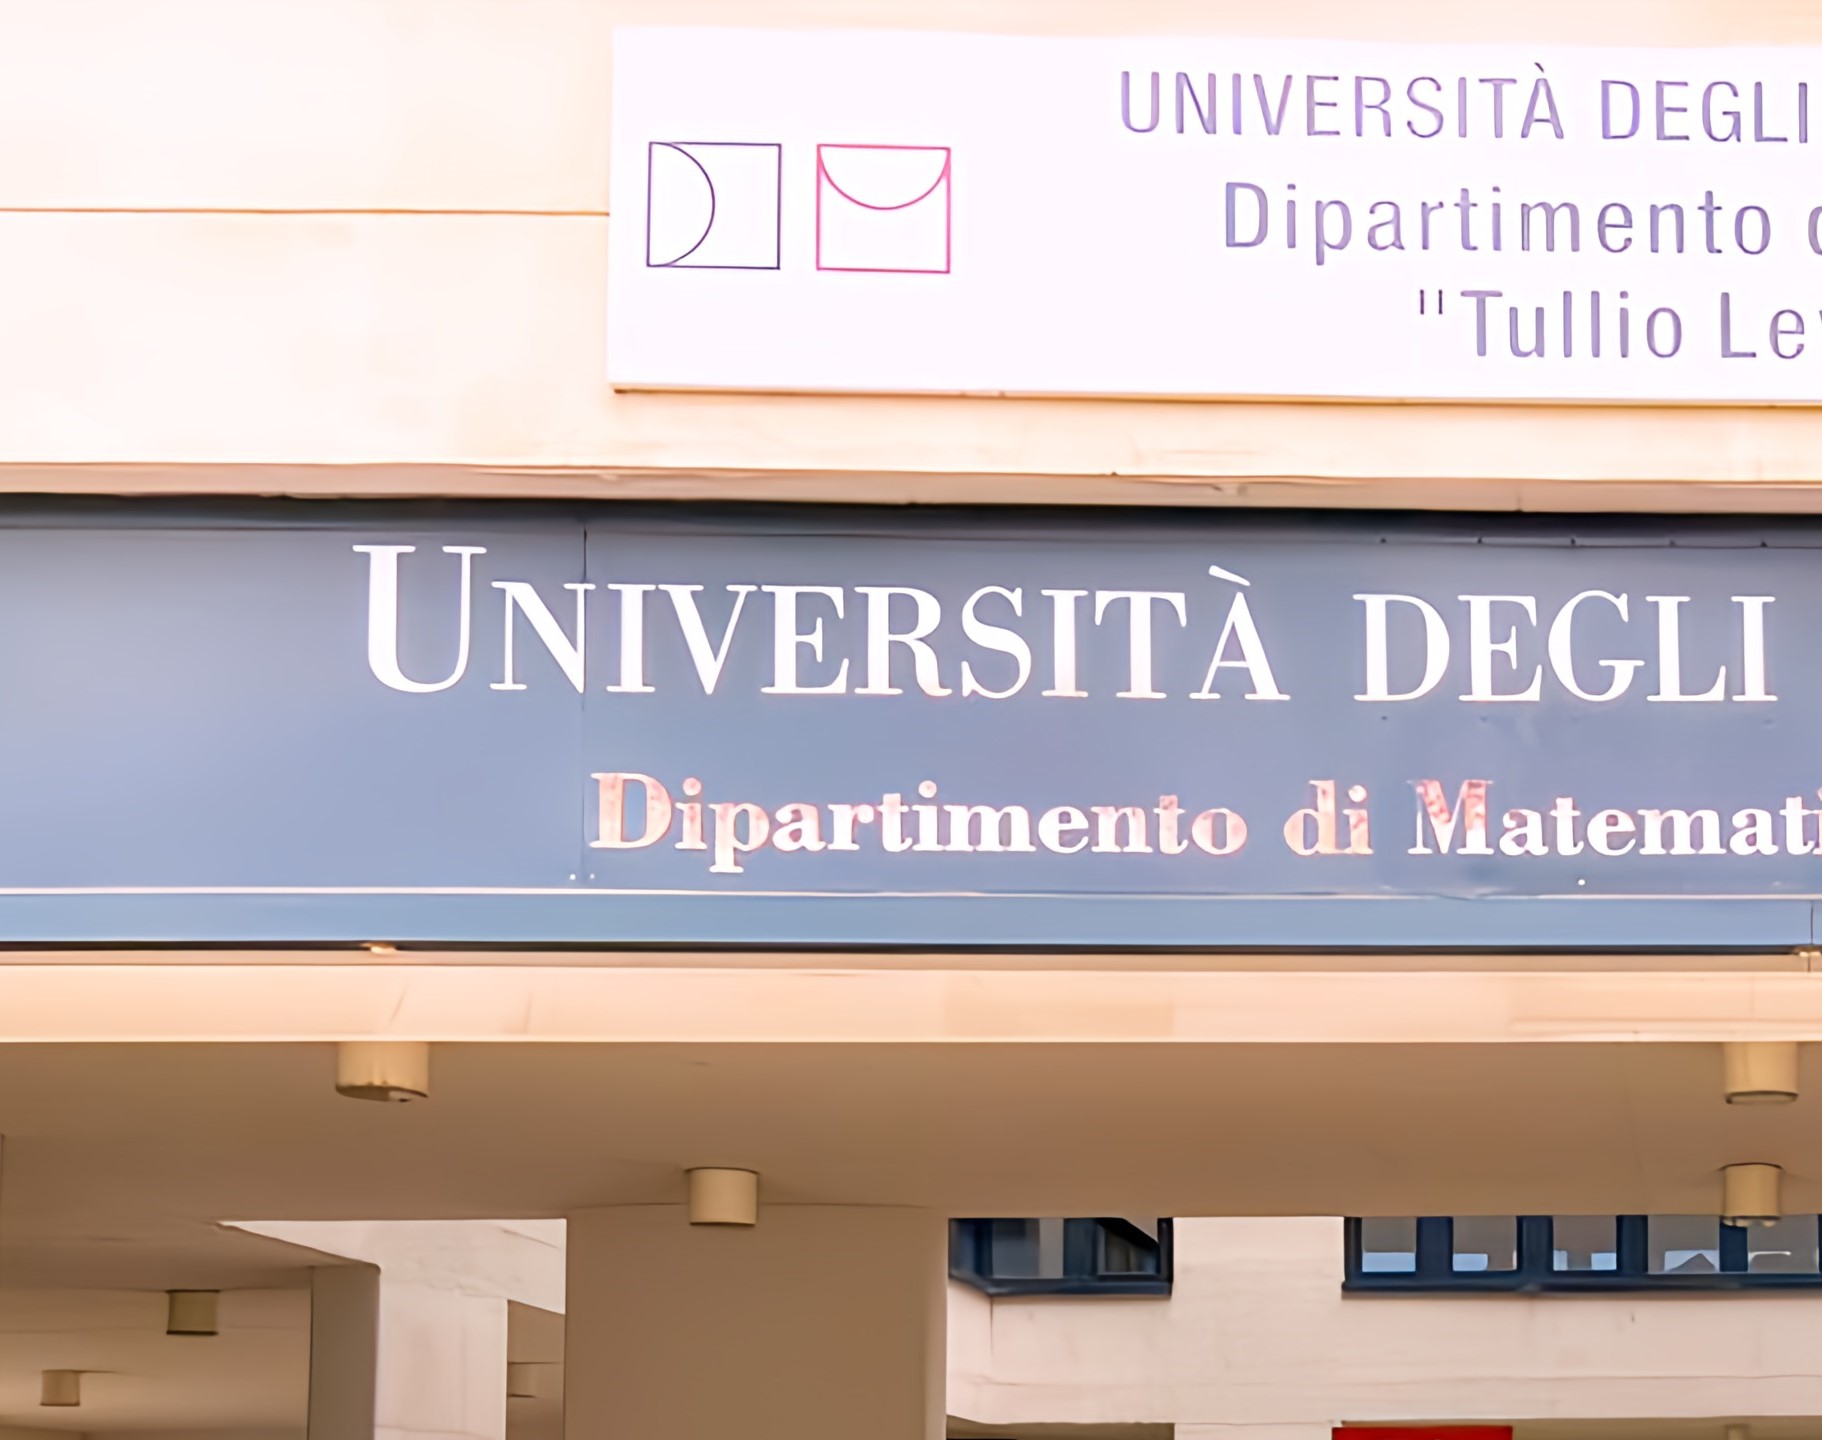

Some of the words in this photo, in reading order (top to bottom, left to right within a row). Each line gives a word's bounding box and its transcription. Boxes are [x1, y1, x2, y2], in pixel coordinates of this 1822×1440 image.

[1119, 61, 1566, 141] UNIVERSITÀ
[1600, 79, 1810, 144] DEGLI
[1225, 181, 1773, 267] Dipartimento
[1418, 288, 1684, 359] "Tullio
[352, 544, 1292, 701] UNIVERSITÀ
[1352, 589, 1779, 702] DEGLI
[588, 772, 1249, 874] Dipartimento
[1283, 779, 1375, 857] di
